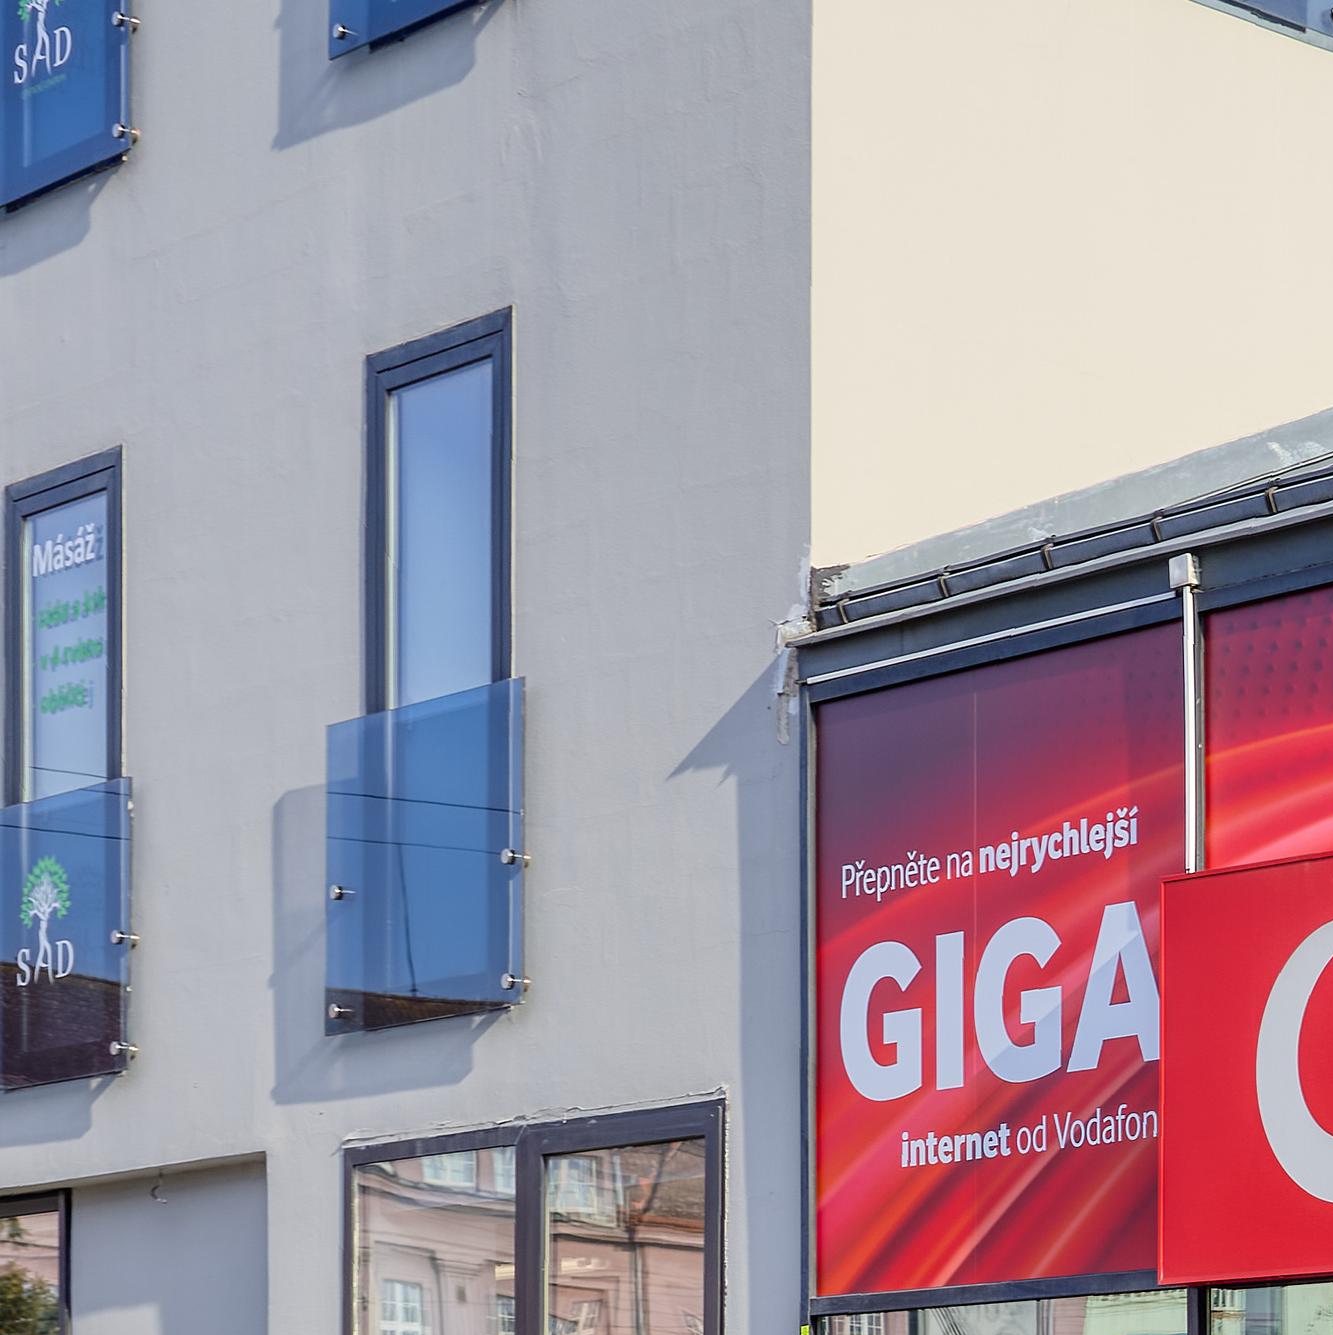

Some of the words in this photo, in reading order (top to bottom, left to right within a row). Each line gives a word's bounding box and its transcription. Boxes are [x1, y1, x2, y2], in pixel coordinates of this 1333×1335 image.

[842, 851, 940, 901] Přepněte
[946, 850, 972, 881] na
[979, 806, 1140, 878] nejrychlejší
[840, 901, 1160, 1101] GIGA
[901, 1122, 1011, 1168] internet
[1016, 1115, 1047, 1154] od
[1053, 1103, 1159, 1150] Vodafon
